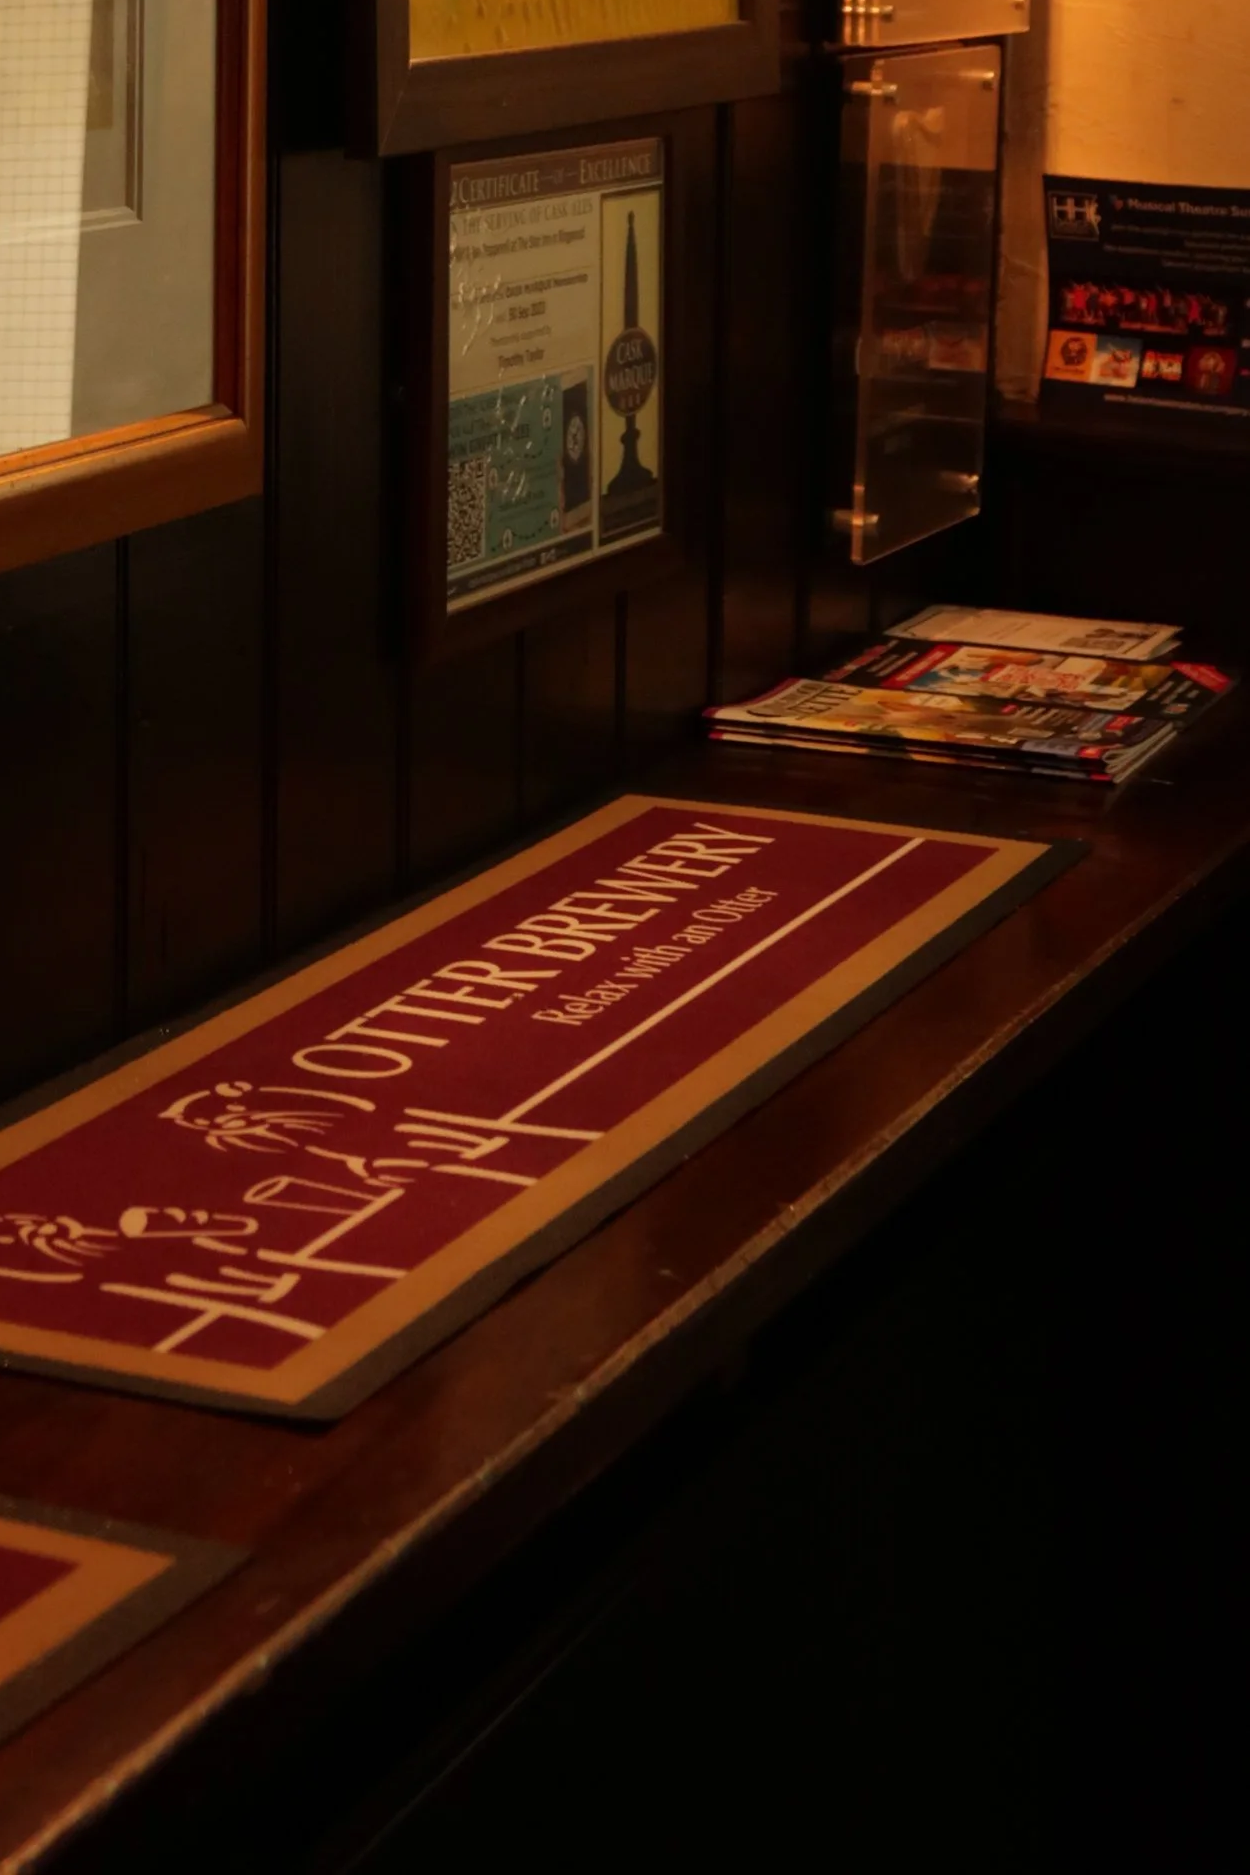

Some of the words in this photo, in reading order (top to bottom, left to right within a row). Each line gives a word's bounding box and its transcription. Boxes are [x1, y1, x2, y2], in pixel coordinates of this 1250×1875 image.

[458, 169, 540, 204] CERTIFICATE
[579, 153, 652, 185] EXCELLENCE
[1126, 198, 1175, 213] Musical
[1178, 201, 1227, 217] Theatre
[616, 338, 644, 365] CASK
[609, 361, 652, 392] MARQUE
[692, 885, 779, 925] Otter
[290, 957, 563, 1080] OTTER
[481, 822, 775, 962] BREWERY
[684, 921, 724, 945] an
[619, 944, 692, 981] with
[531, 981, 639, 1026] Relax
